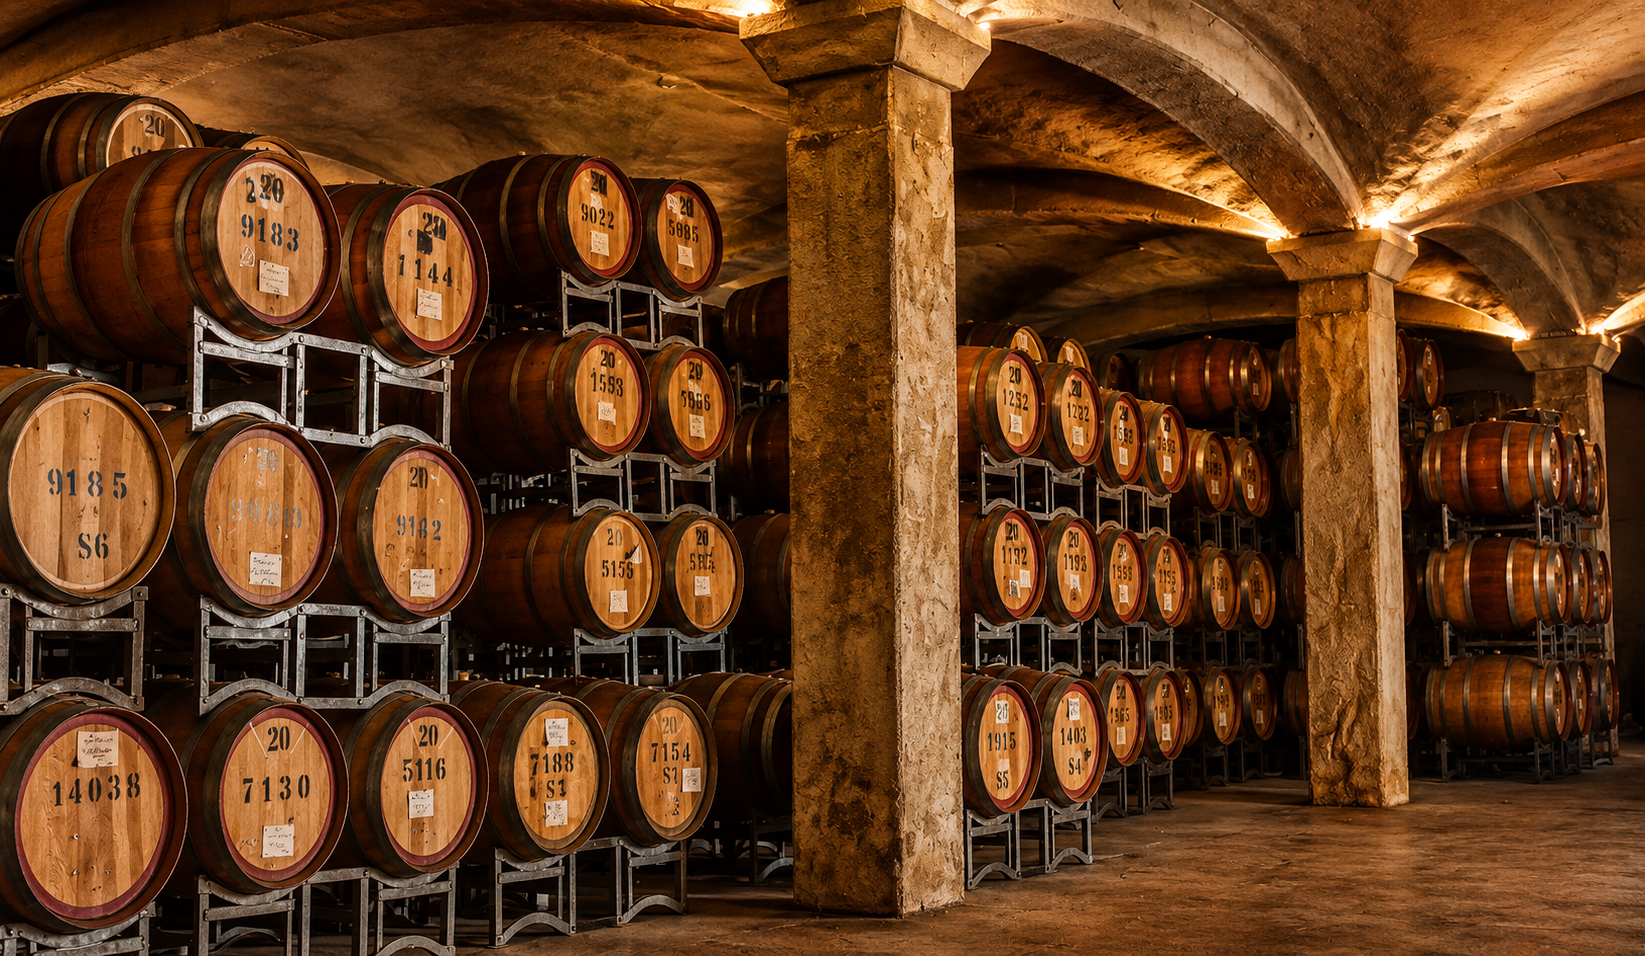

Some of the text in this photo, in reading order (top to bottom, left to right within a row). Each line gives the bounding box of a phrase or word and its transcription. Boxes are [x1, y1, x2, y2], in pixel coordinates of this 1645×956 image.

[144, 114, 165, 138] 20
[581, 203, 614, 230] 9022
[241, 213, 299, 252] 9183
[399, 254, 453, 287] 1144
[600, 349, 616, 369] 20
[689, 361, 703, 381] 20
[1009, 366, 1022, 385] 20
[46, 468, 128, 499] 9185
[78, 532, 109, 560] S6
[607, 528, 623, 547] 20
[695, 526, 709, 547] 20
[1068, 530, 1080, 548] 20
[418, 724, 438, 748] 20
[661, 715, 678, 735] 20
[1060, 726, 1087, 746] 1403
[267, 725, 291, 752] 20
[987, 731, 1017, 752] 1915
[530, 751, 575, 776] 7188
[650, 741, 692, 763] 7154
[402, 757, 446, 783] 5116
[1068, 757, 1081, 775] S4
[52, 772, 141, 807] 14038
[242, 774, 311, 804] 7130
[996, 770, 1009, 790] S5
